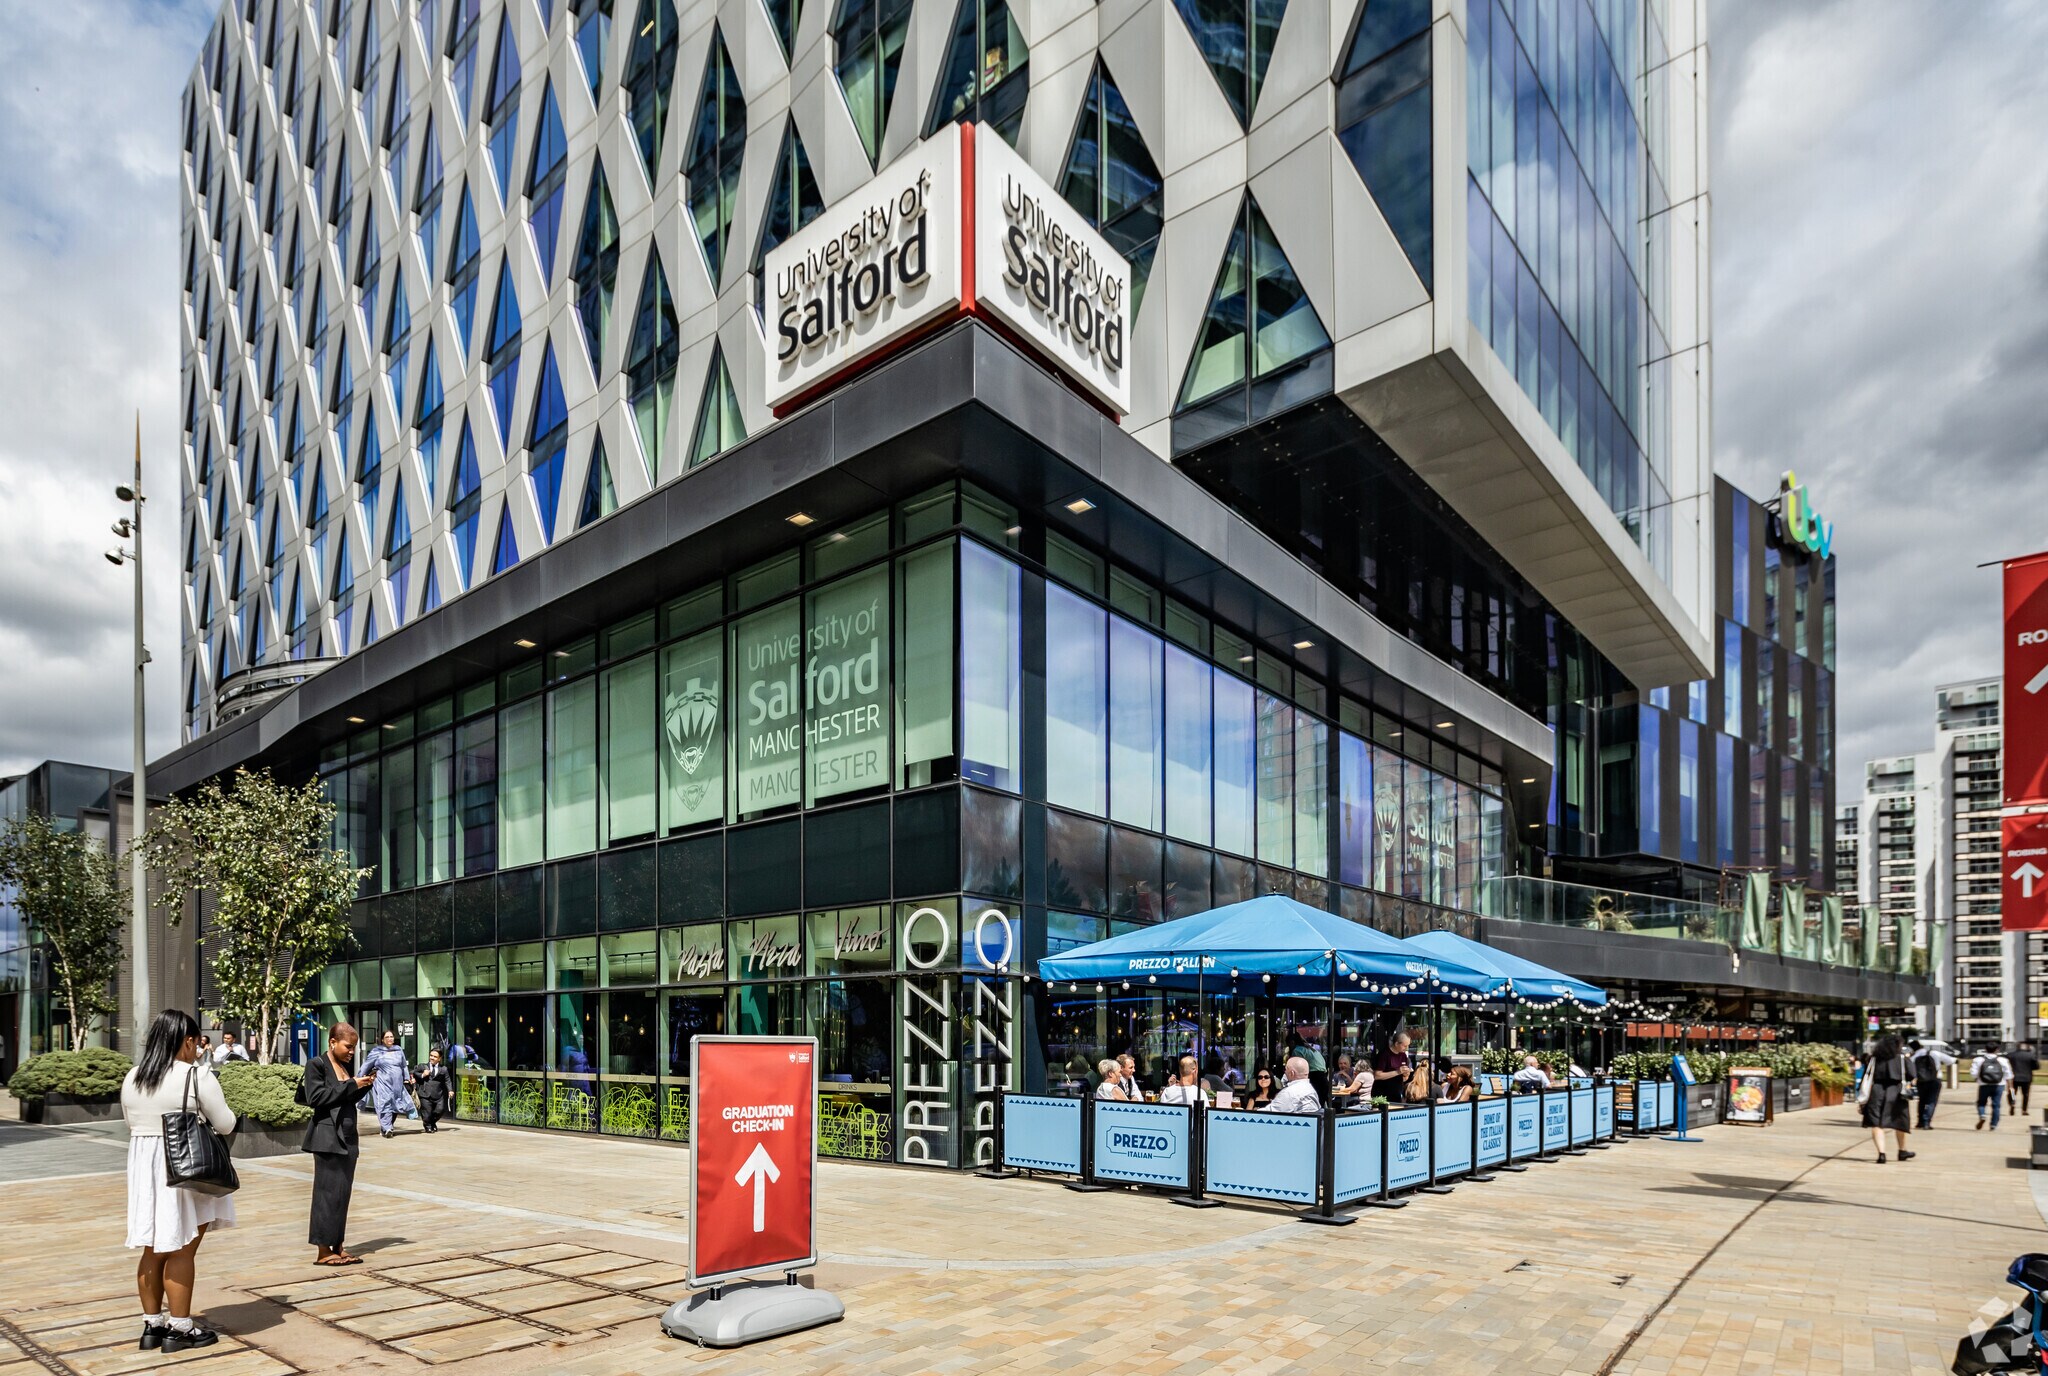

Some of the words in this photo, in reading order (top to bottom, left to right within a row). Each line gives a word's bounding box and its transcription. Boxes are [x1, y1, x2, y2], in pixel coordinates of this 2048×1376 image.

[777, 197, 895, 301] University
[899, 167, 931, 222] of
[1004, 173, 1105, 294] University
[1105, 278, 1123, 310] of
[777, 214, 930, 362] Salford
[1003, 225, 1123, 371] Salford
[748, 614, 852, 672] University
[855, 599, 878, 635] of
[748, 637, 879, 726] Salford
[750, 704, 880, 760] MANCHESTER
[1409, 843, 1455, 872] MANCSTER
[748, 931, 800, 972] Pizza
[834, 916, 890, 961] Vino
[677, 942, 724, 981] Pasta
[1129, 958, 1170, 970] PREZZO
[903, 908, 950, 1166] PREZZO
[722, 1105, 794, 1120] GRADUATION
[732, 1118, 784, 1133] CHECK-IN
[1489, 1125, 1504, 1137] ITALIAN
[1496, 1112, 1501, 1122] OF
[1113, 1133, 1168, 1151] PREZZO
[1127, 1151, 1152, 1159] ITALIAN
[1399, 1138, 1419, 1154] PREZZO
[1483, 1137, 1501, 1150] CLASSICS
